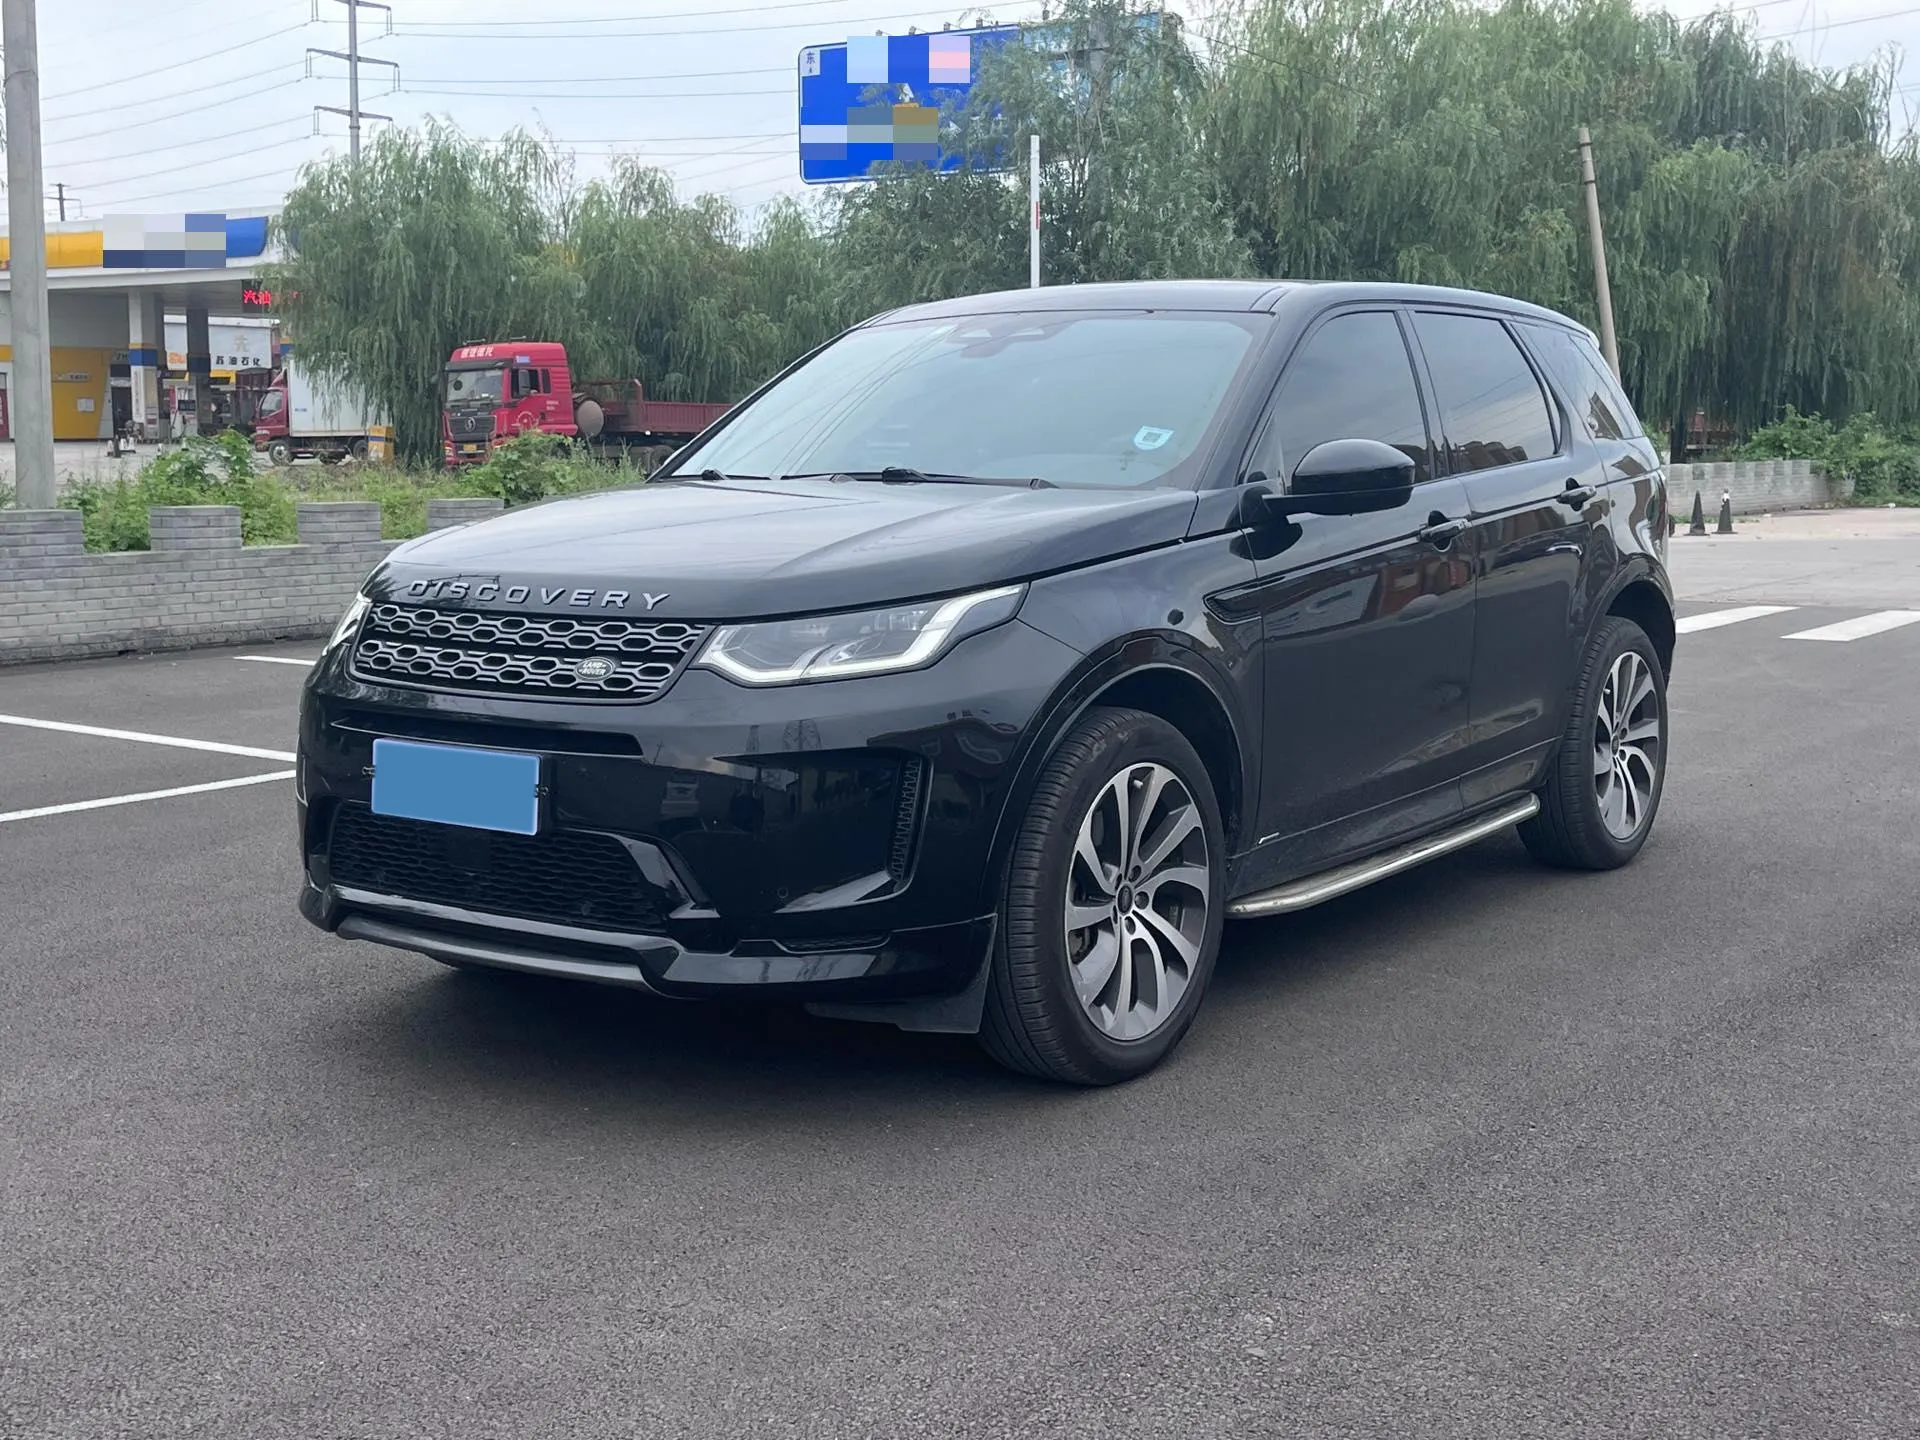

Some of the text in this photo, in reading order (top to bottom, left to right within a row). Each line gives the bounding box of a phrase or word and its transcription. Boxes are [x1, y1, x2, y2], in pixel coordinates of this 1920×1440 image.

[806, 51, 816, 65] 东
[243, 289, 271, 305] 汽油
[407, 579, 669, 611] DISCOVERY
[580, 668, 607, 676] ROVER
[582, 661, 604, 669] LAND
